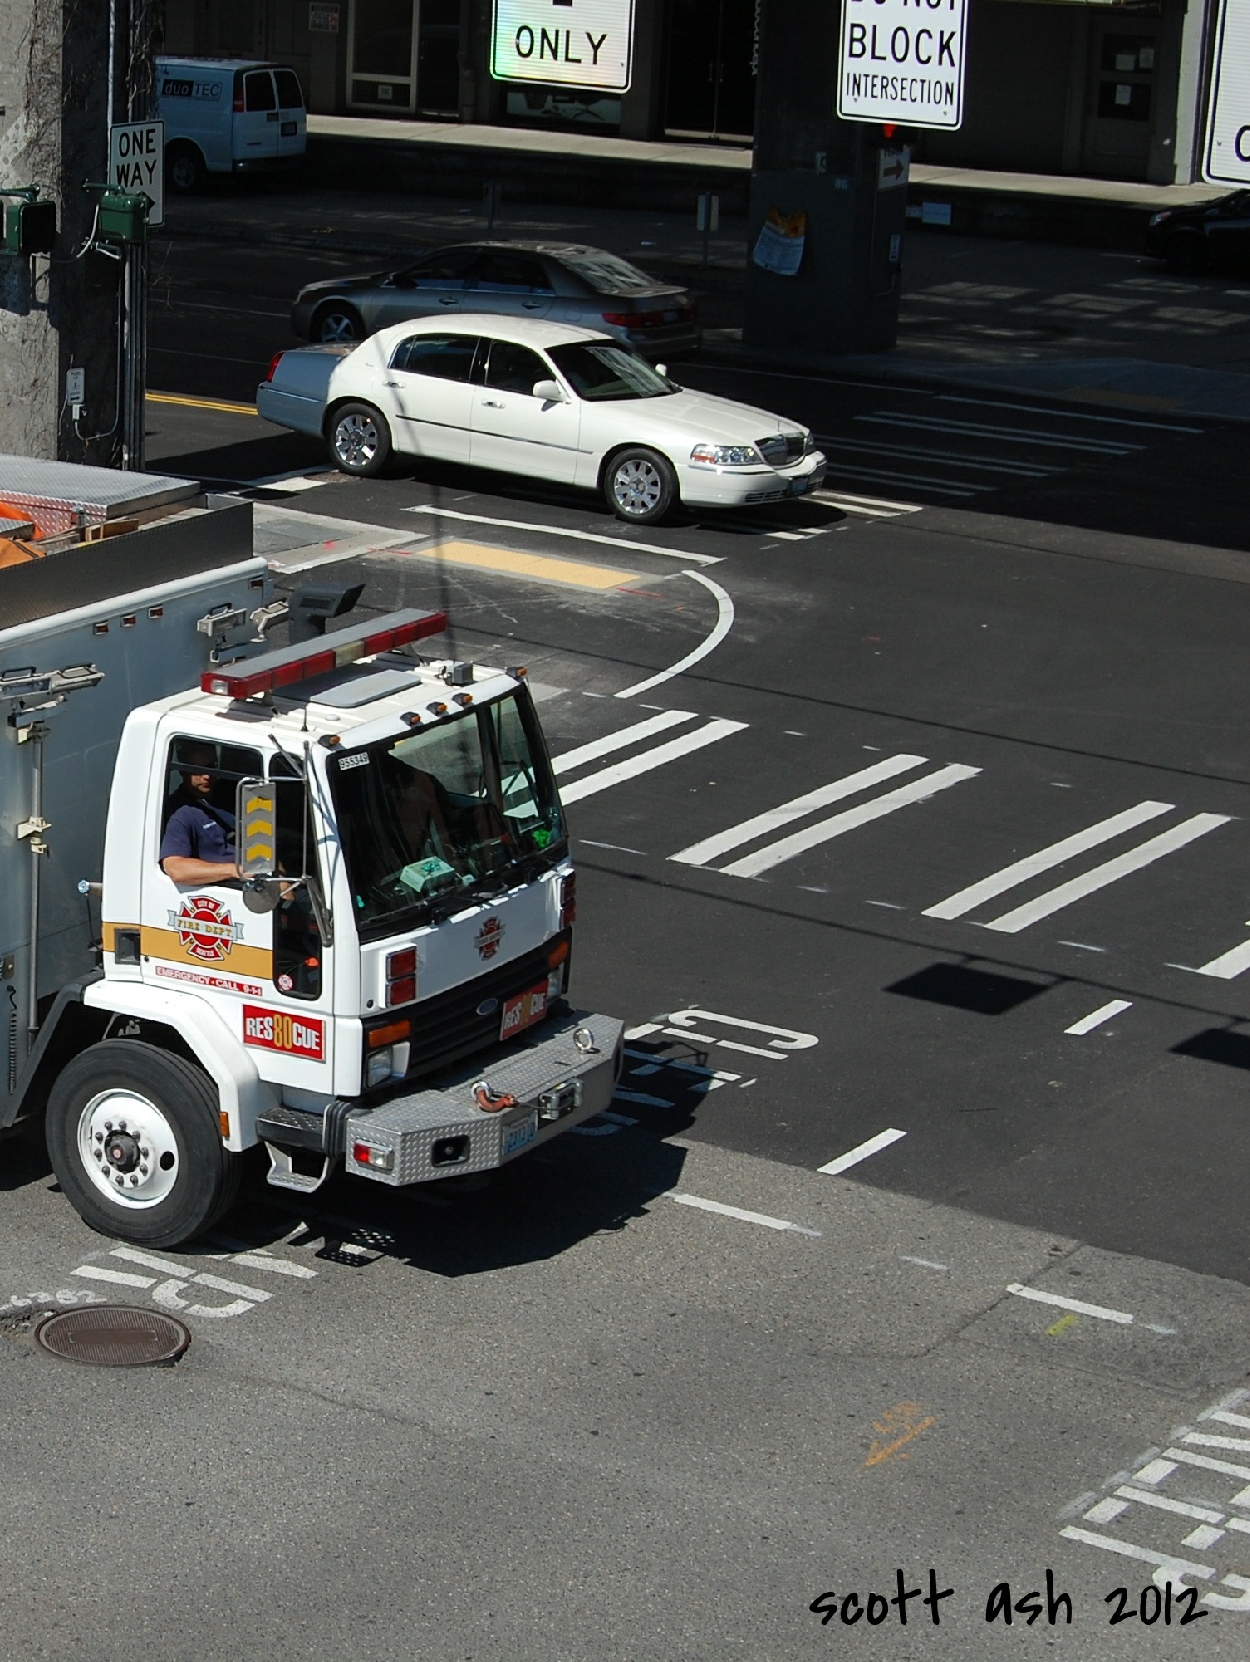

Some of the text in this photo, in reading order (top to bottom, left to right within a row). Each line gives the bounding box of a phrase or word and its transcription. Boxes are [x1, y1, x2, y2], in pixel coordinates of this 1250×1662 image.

[515, 25, 608, 66] ONLY
[849, 23, 956, 67] BLOCK
[846, 73, 954, 105] INTERSECTION
[119, 128, 156, 157] ONE
[116, 160, 157, 187] WAY
[178, 918, 200, 931] FIRE
[157, 966, 210, 985] EMERGENCY
[216, 979, 238, 991] CALL
